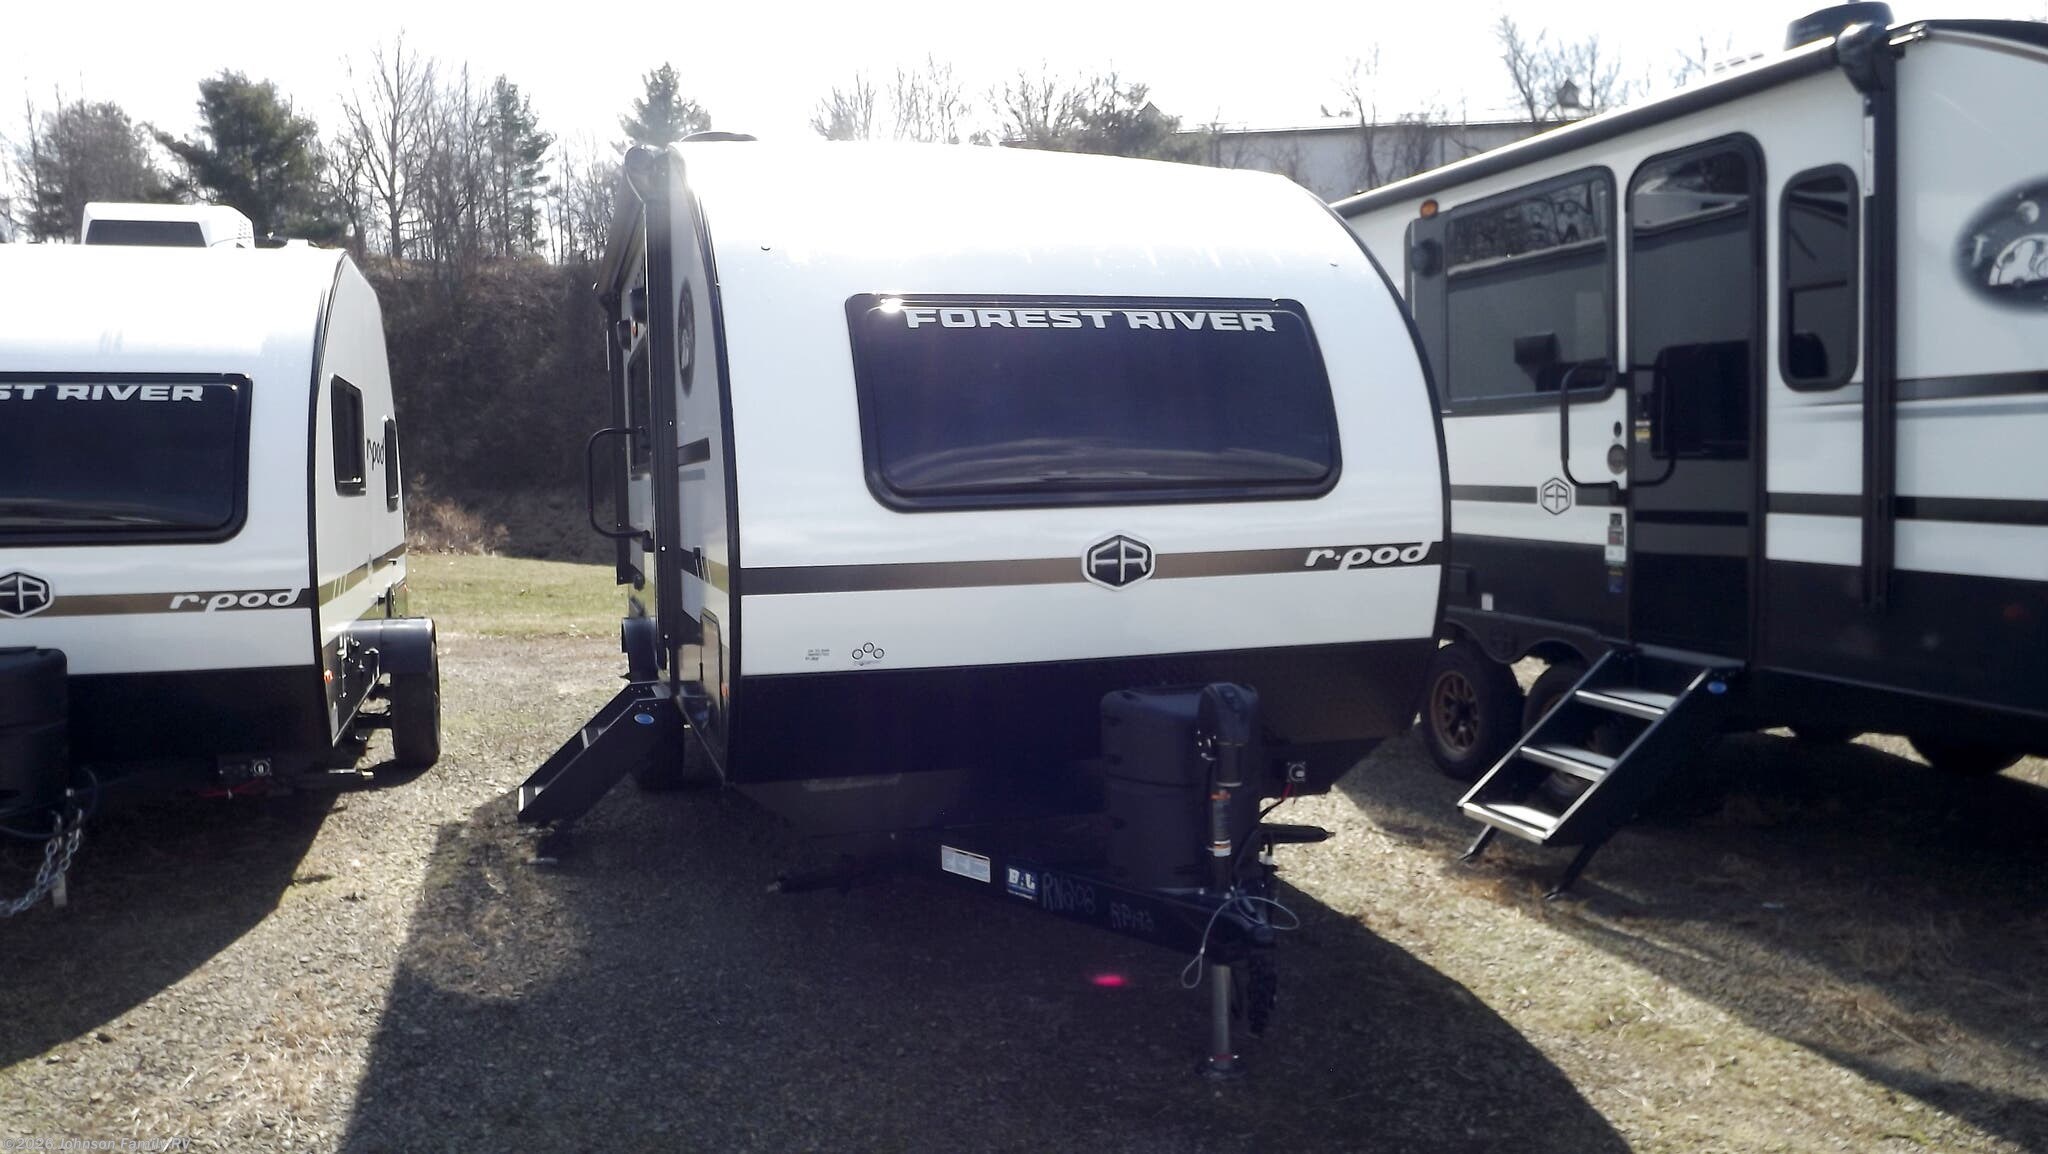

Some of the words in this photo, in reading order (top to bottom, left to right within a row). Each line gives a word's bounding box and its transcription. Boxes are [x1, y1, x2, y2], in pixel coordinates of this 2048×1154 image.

[905, 308, 1112, 329] FOREST
[1124, 310, 1277, 333] RIVER
[56, 384, 204, 402] RIVER
